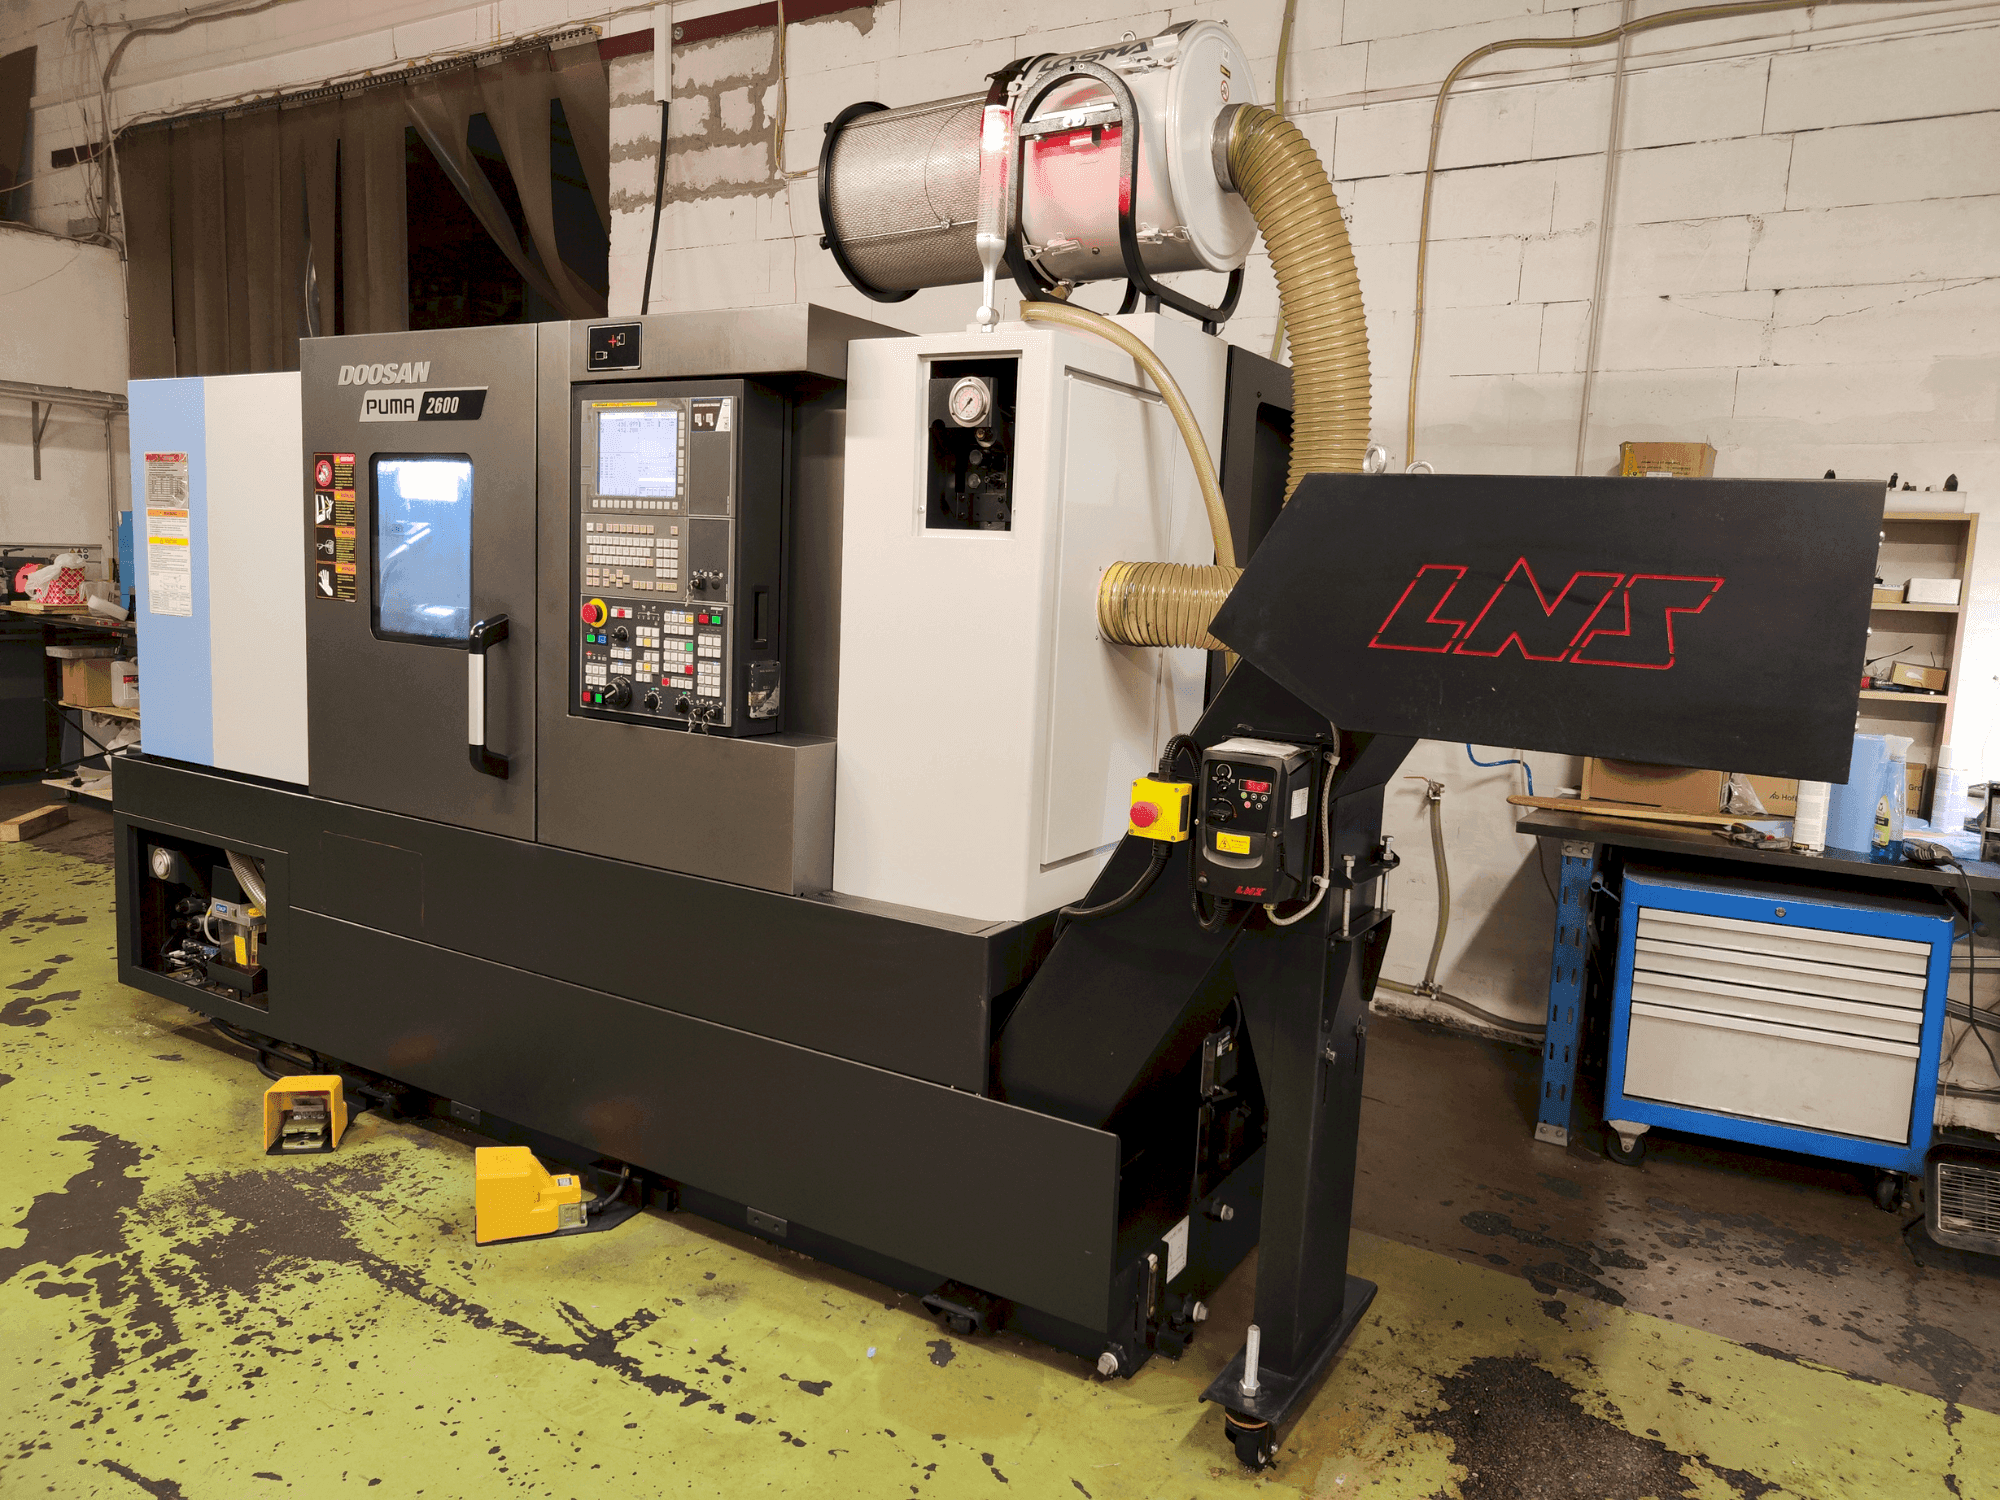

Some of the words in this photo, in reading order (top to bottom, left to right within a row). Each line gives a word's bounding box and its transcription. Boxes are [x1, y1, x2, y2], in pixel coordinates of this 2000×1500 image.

[1039, 41, 1148, 72] LOSMA
[338, 361, 431, 386] DOOSAN
[366, 398, 415, 415] PUMA
[426, 397, 460, 414] 2600
[1368, 556, 1727, 670] LNS
[1235, 885, 1267, 897] LNS
